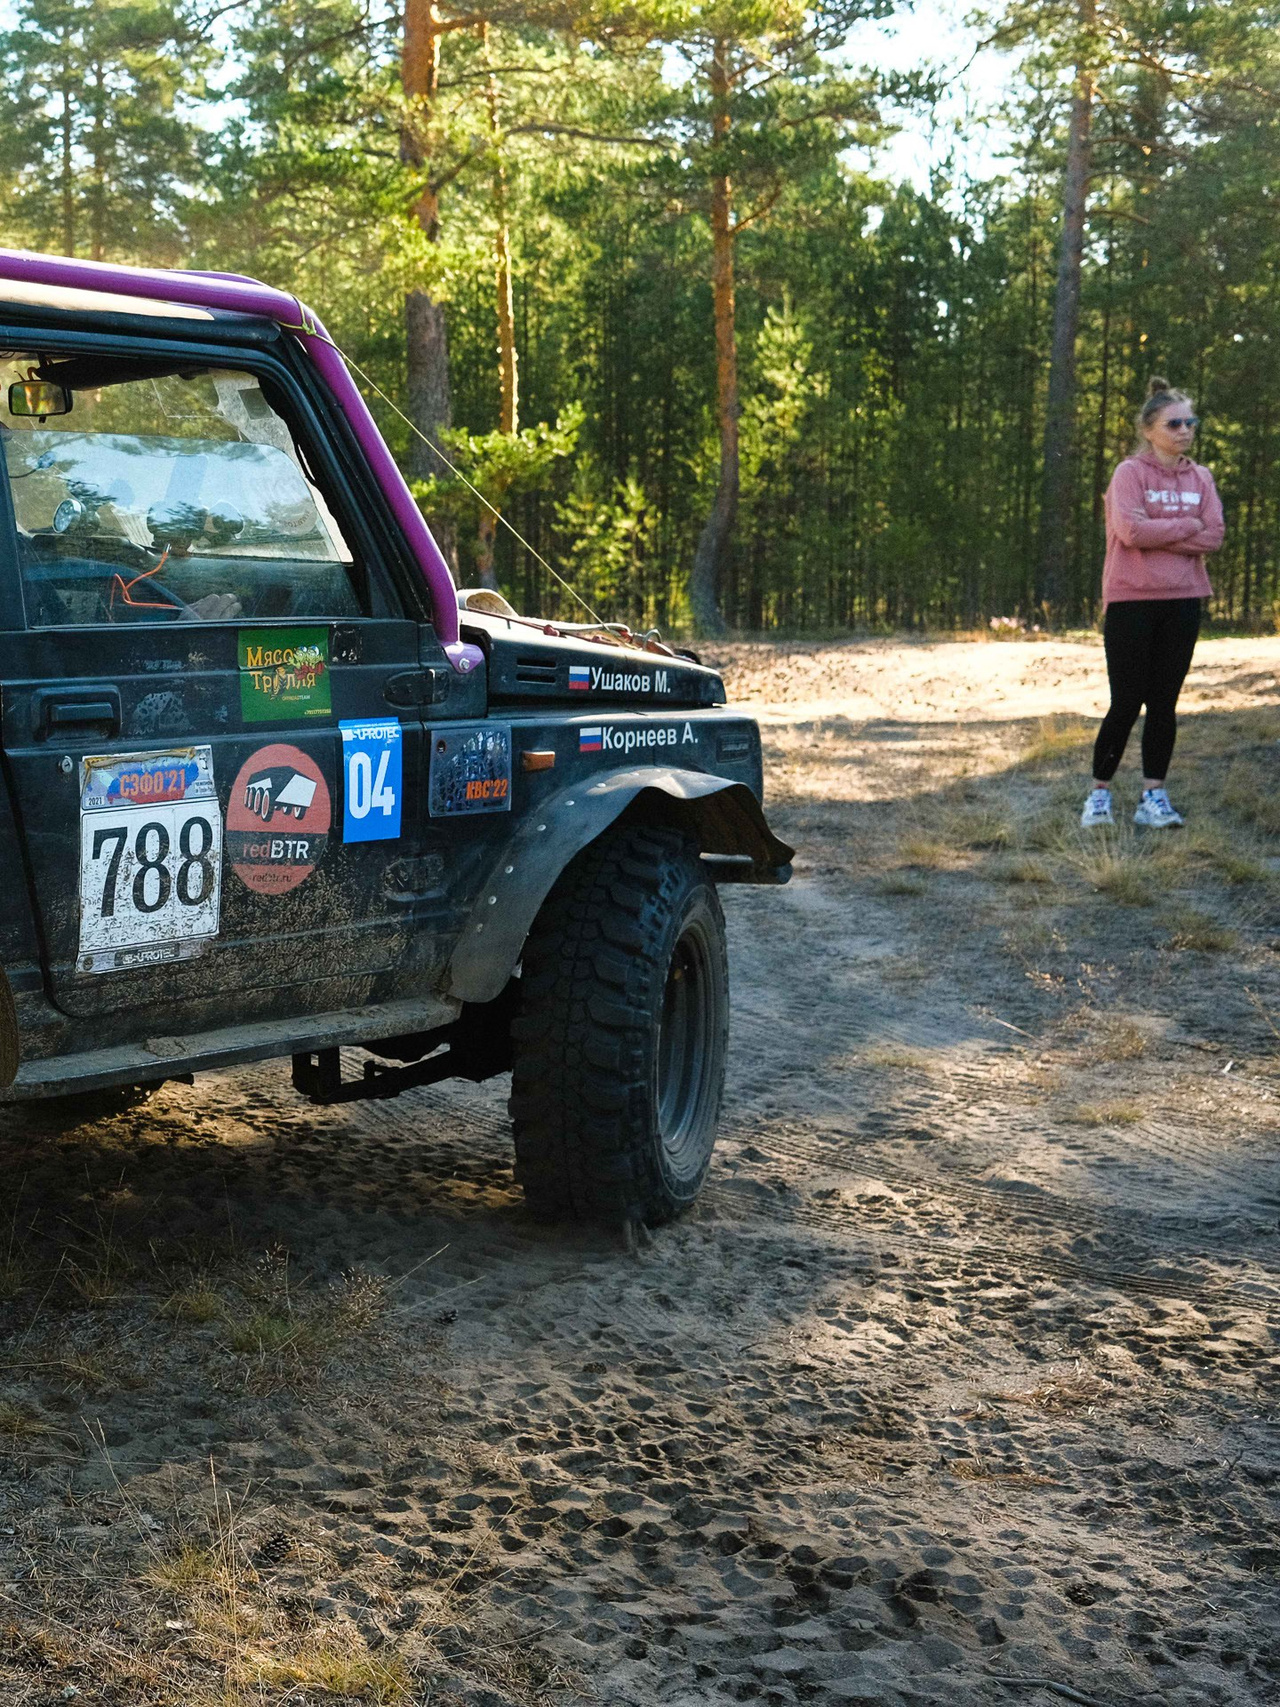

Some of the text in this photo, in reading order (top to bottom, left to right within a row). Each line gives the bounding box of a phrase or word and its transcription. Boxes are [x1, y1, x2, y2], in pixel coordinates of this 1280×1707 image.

[246, 646, 293, 668] Мясо
[591, 667, 671, 693] Ушаков М.
[351, 727, 400, 740] SUPROTEC
[602, 722, 699, 754] Корнеев А.
[120, 768, 186, 798] СЗФО'21
[349, 750, 395, 819] 04
[88, 797, 103, 806] 2021
[243, 840, 309, 859] redBTR
[92, 816, 216, 917] 788
